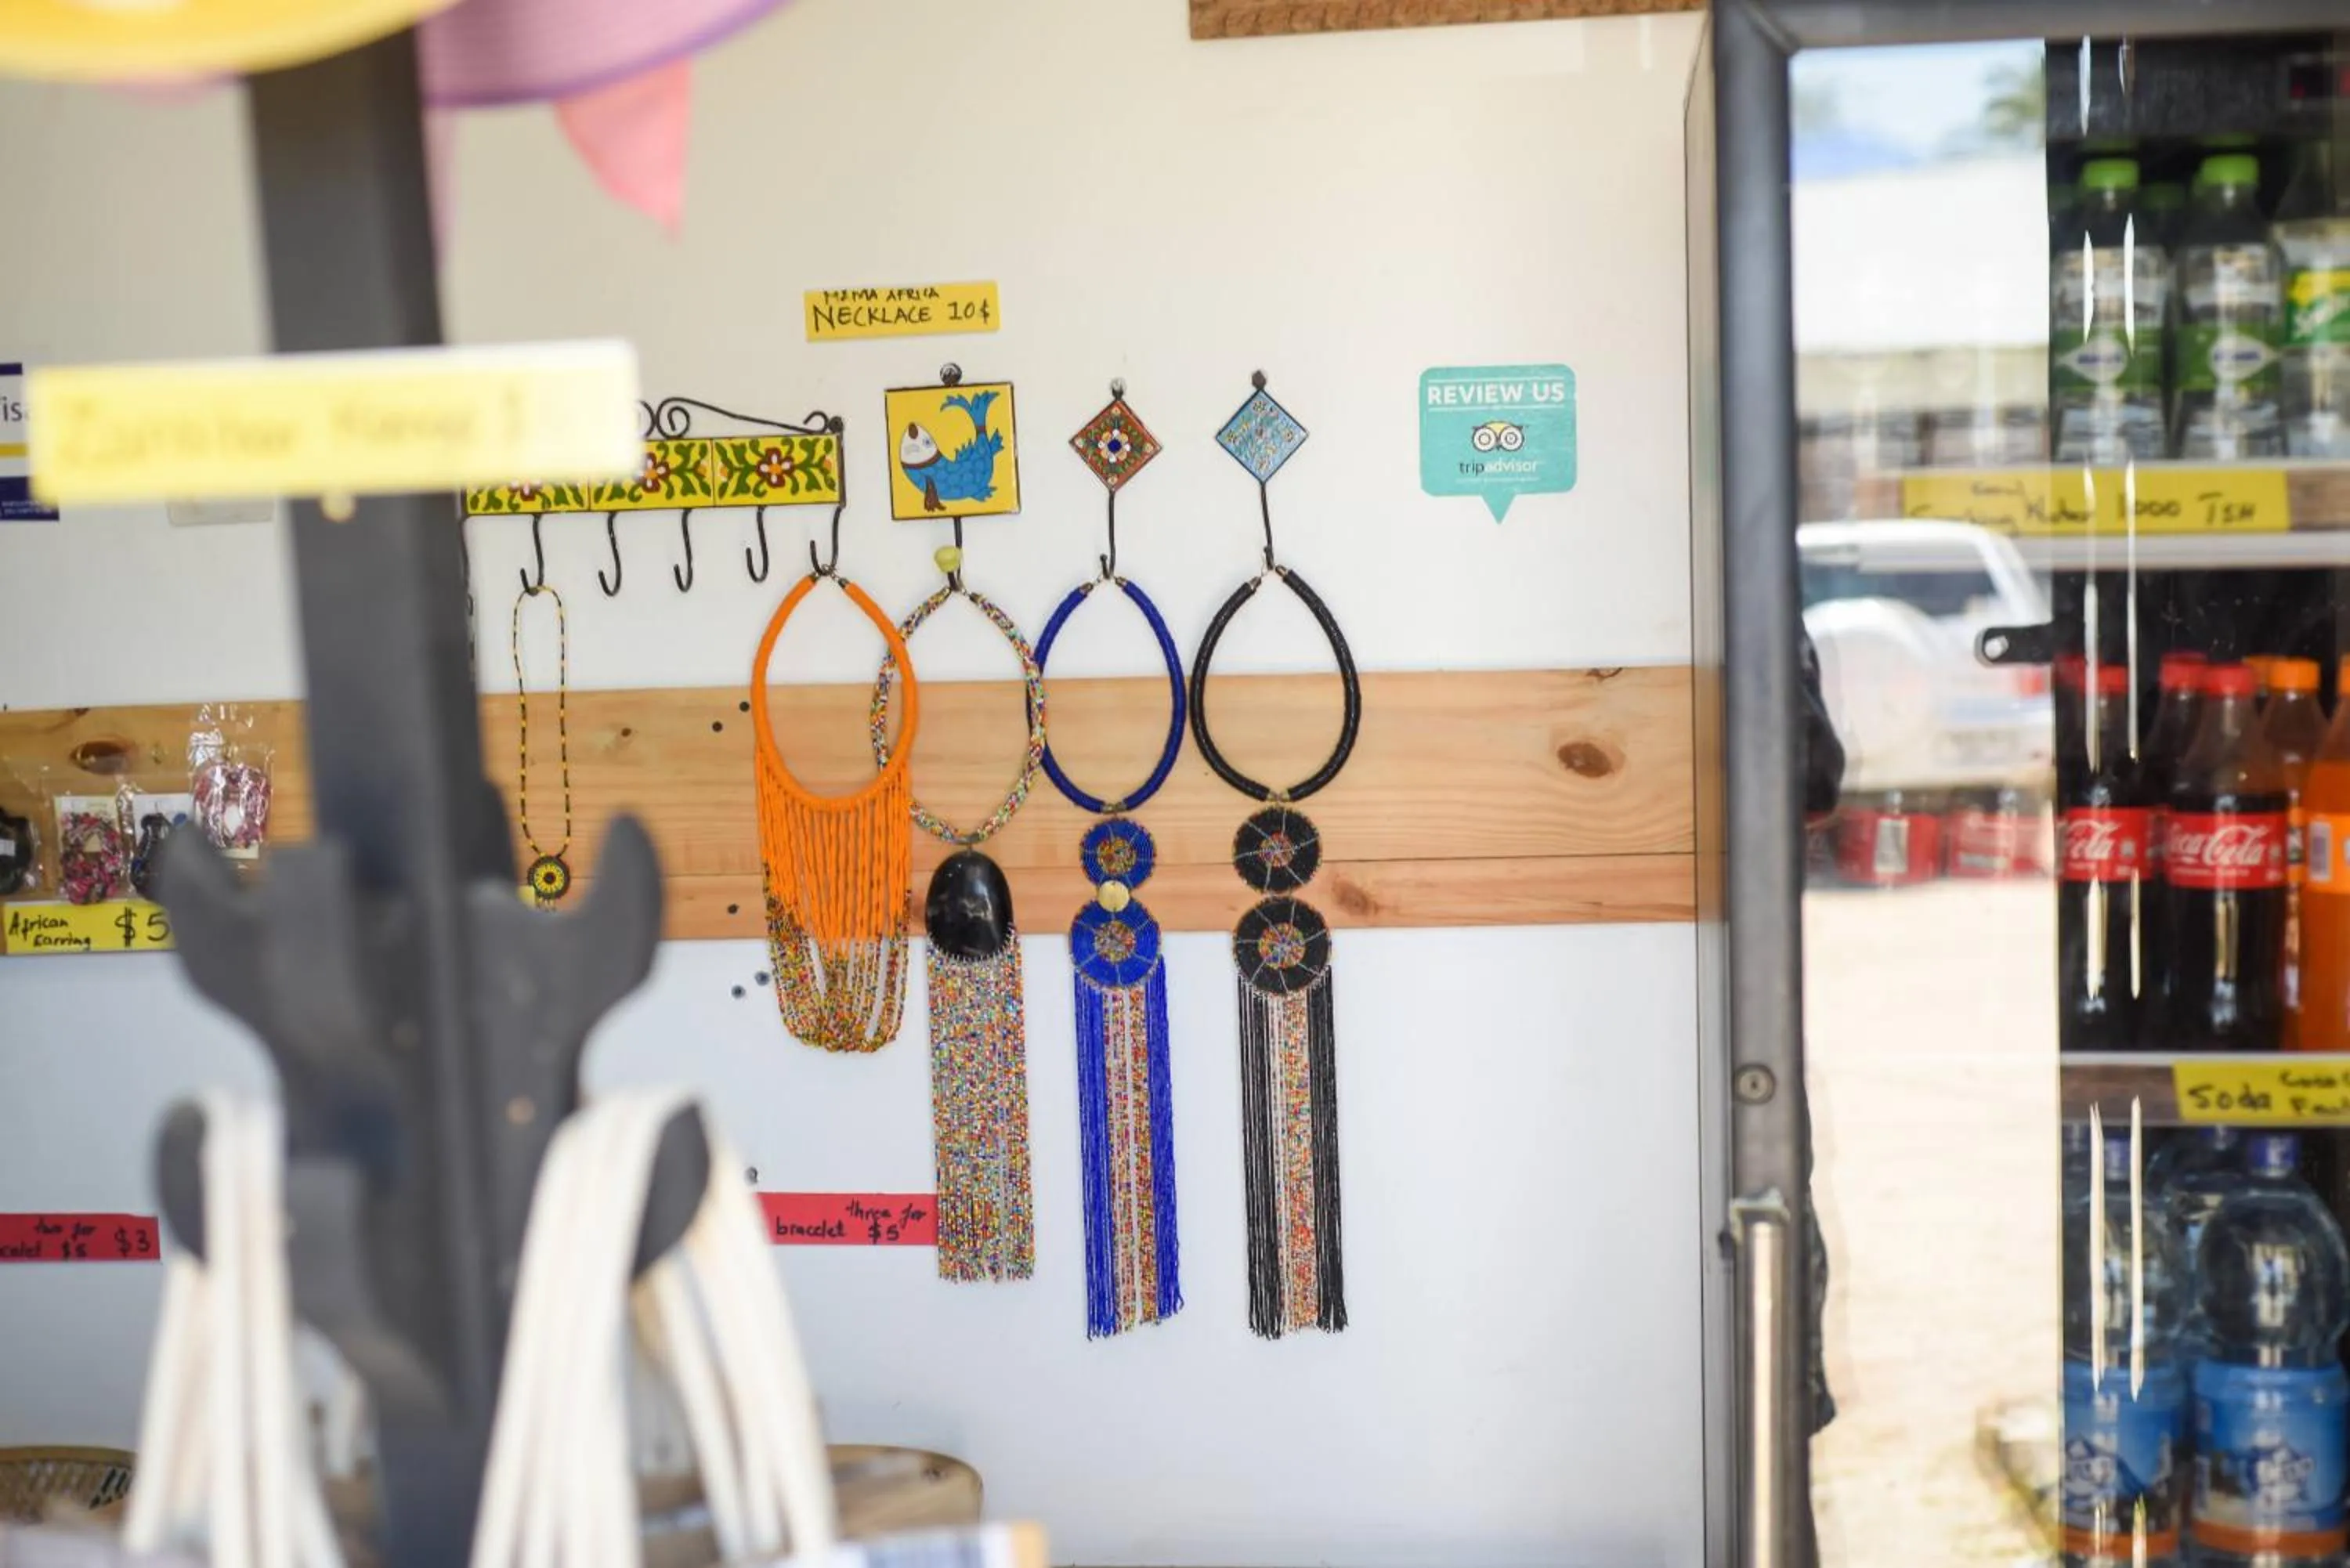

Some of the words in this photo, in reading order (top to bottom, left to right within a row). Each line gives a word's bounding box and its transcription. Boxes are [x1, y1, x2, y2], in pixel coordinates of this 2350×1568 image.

[813, 305, 931, 332] NECKLACE
[1427, 384, 1524, 406] REVIEW
[1532, 382, 1565, 403] US
[1459, 458, 1538, 476] tripadvisor
[9, 911, 69, 941] African
[2188, 1082, 2271, 1111] Soda
